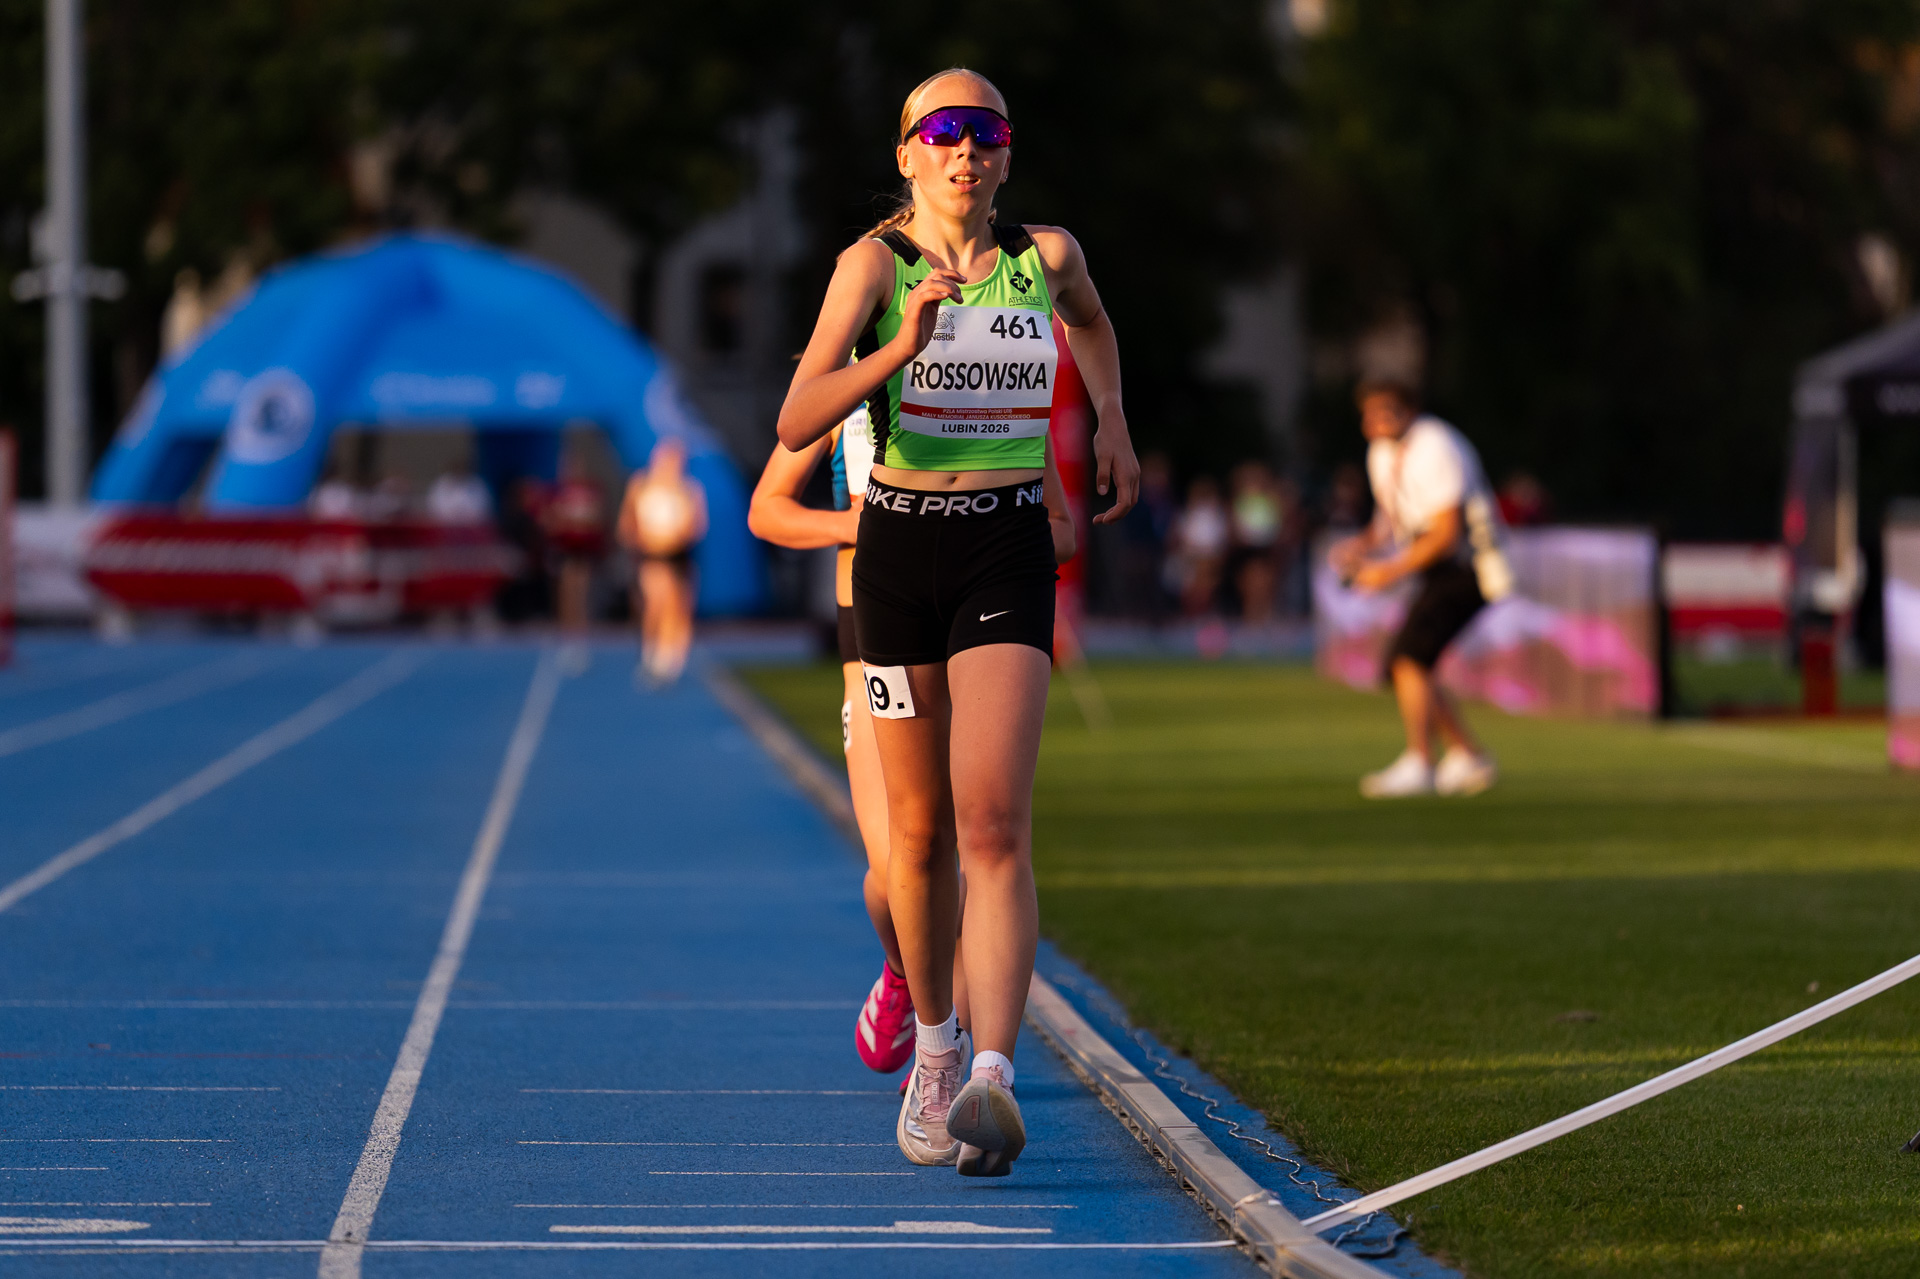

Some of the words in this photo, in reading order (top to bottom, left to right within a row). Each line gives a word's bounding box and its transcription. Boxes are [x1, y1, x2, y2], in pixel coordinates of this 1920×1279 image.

[989, 314, 1043, 340] 461
[910, 360, 1048, 391] ROSSOWSKA
[941, 423, 978, 433] LUBIN
[980, 423, 1010, 434] 2026
[918, 493, 999, 517] PRO
